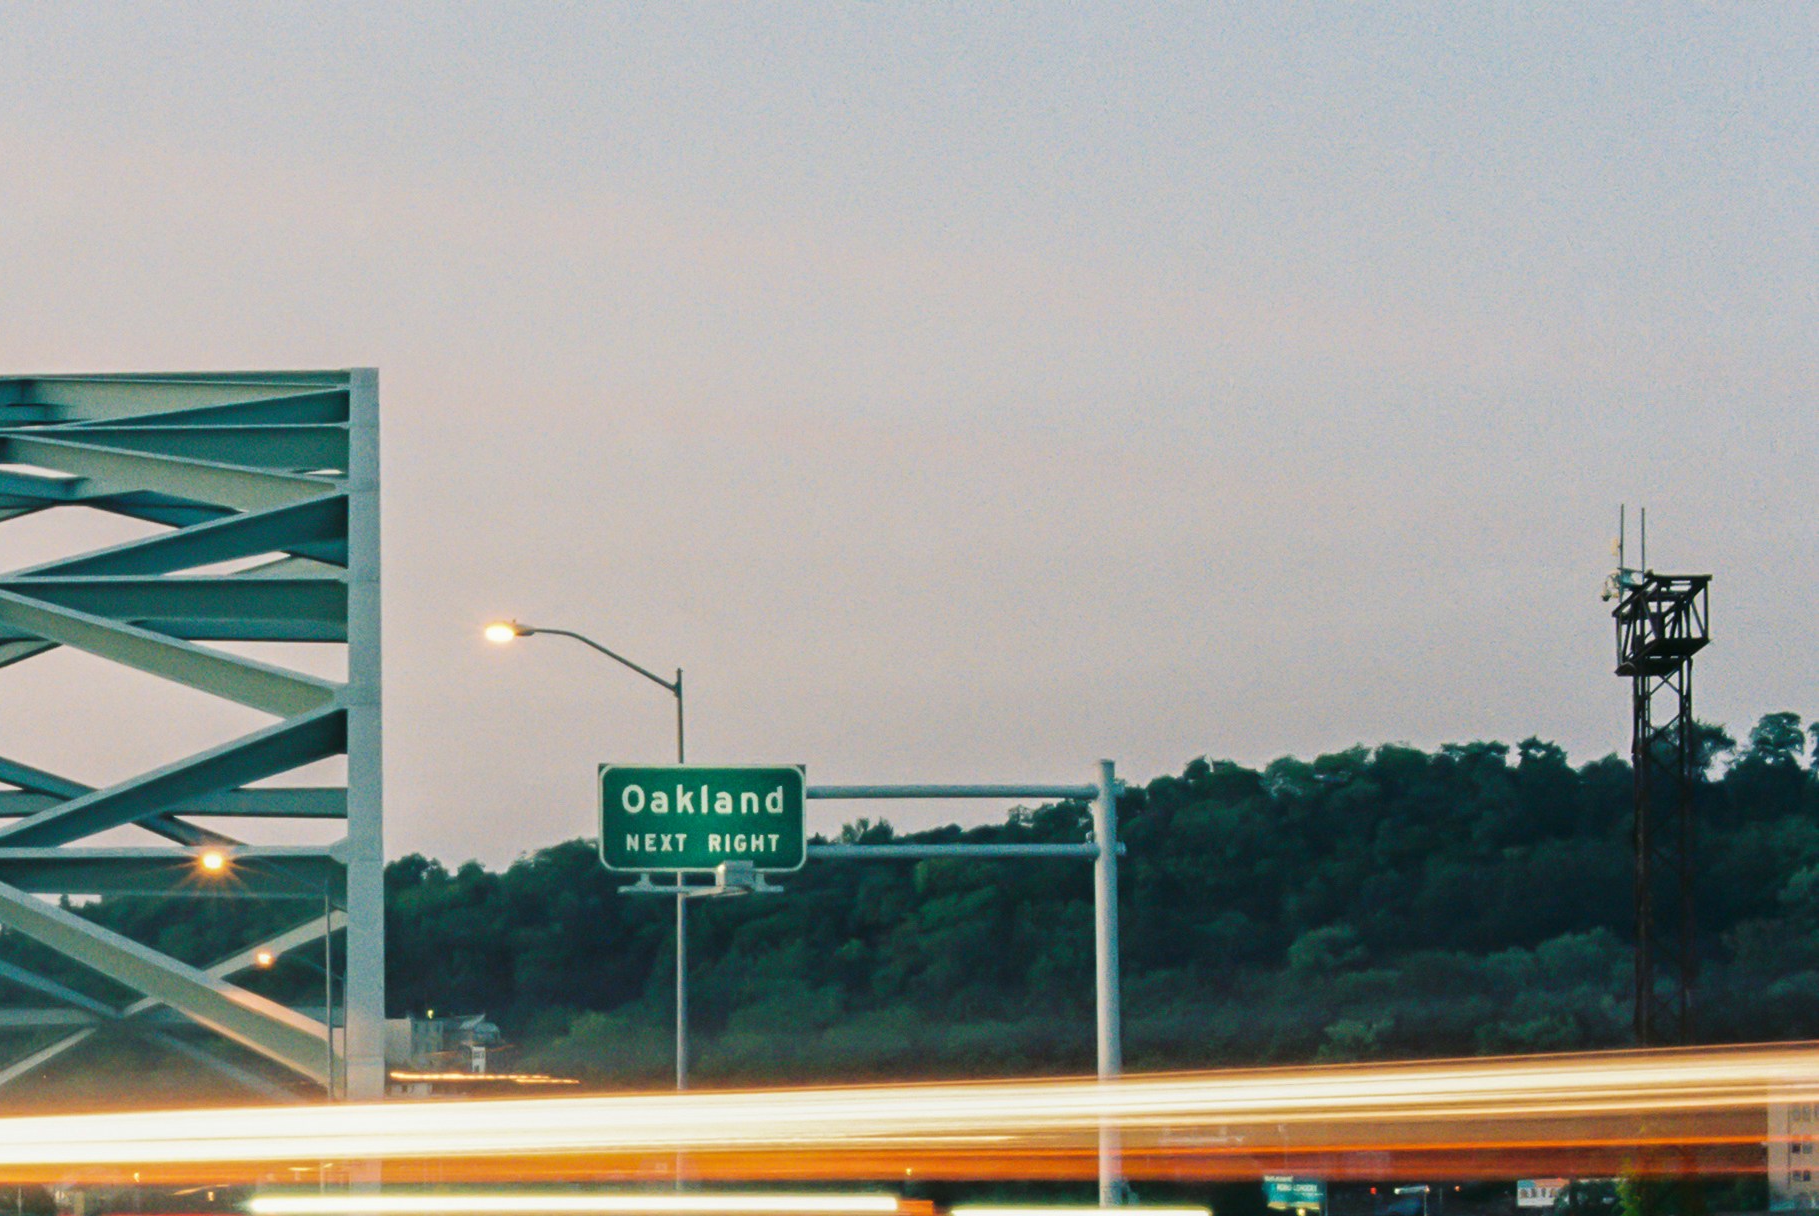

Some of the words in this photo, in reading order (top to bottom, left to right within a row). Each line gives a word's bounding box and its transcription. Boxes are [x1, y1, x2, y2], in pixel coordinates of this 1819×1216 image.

[621, 783, 784, 815] Oakland
[626, 833, 687, 852] NEXT
[707, 833, 780, 853] RIGHT
